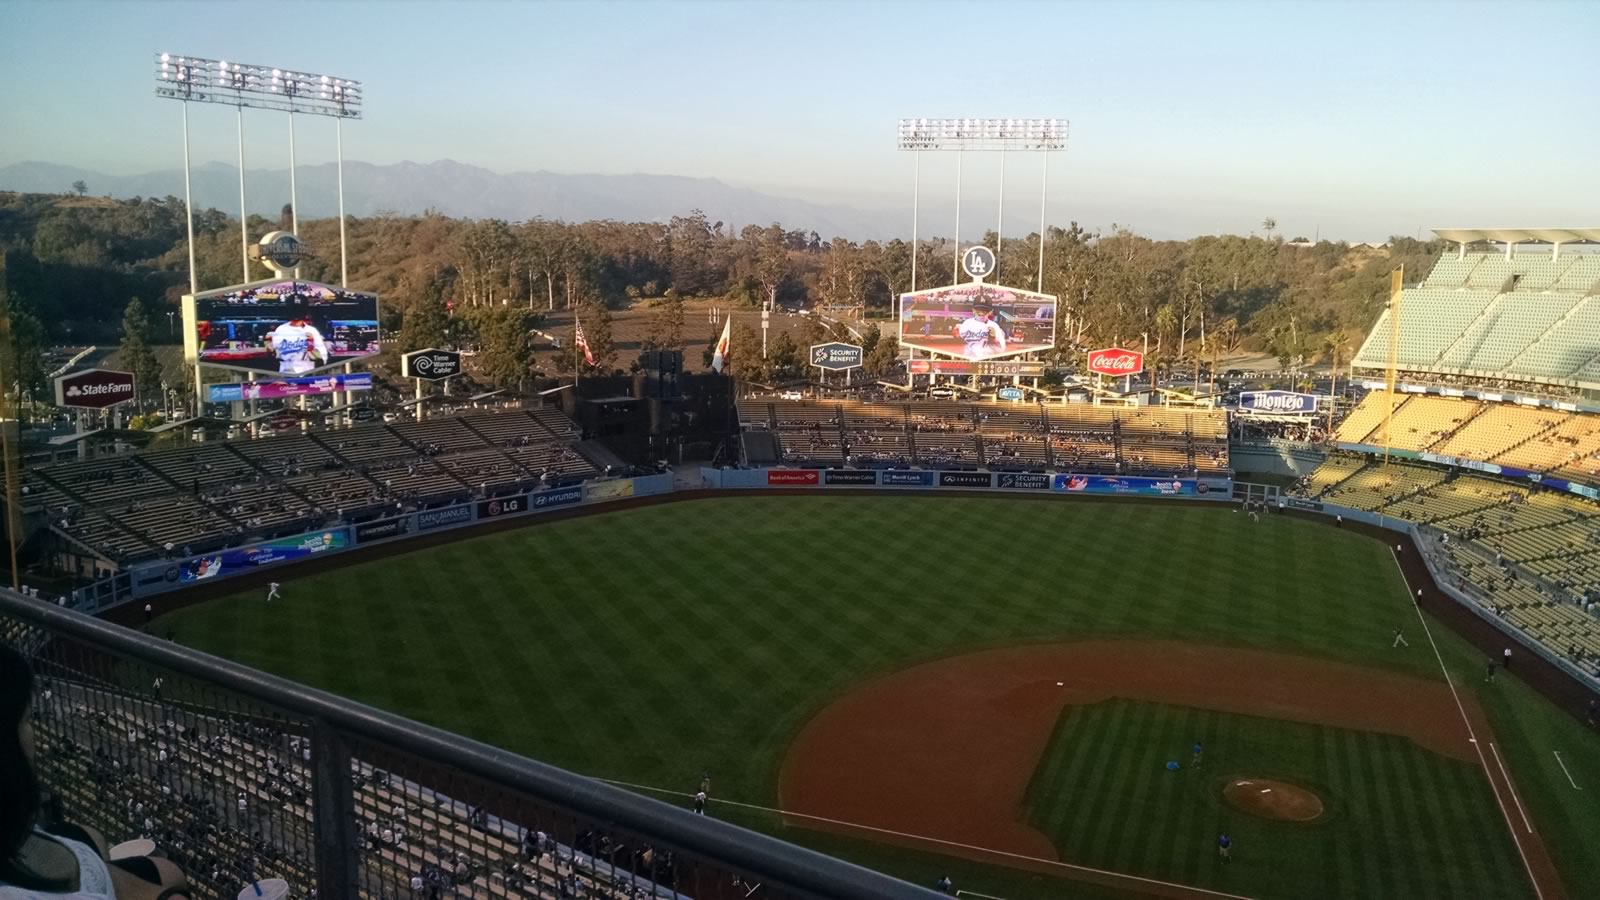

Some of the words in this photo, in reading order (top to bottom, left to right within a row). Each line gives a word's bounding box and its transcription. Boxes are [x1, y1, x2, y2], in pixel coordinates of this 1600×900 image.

[969, 250, 986, 273] LA
[1253, 393, 1304, 410] Montejo
[548, 490, 581, 503] HYUNDAI
[503, 500, 518, 512] LG
